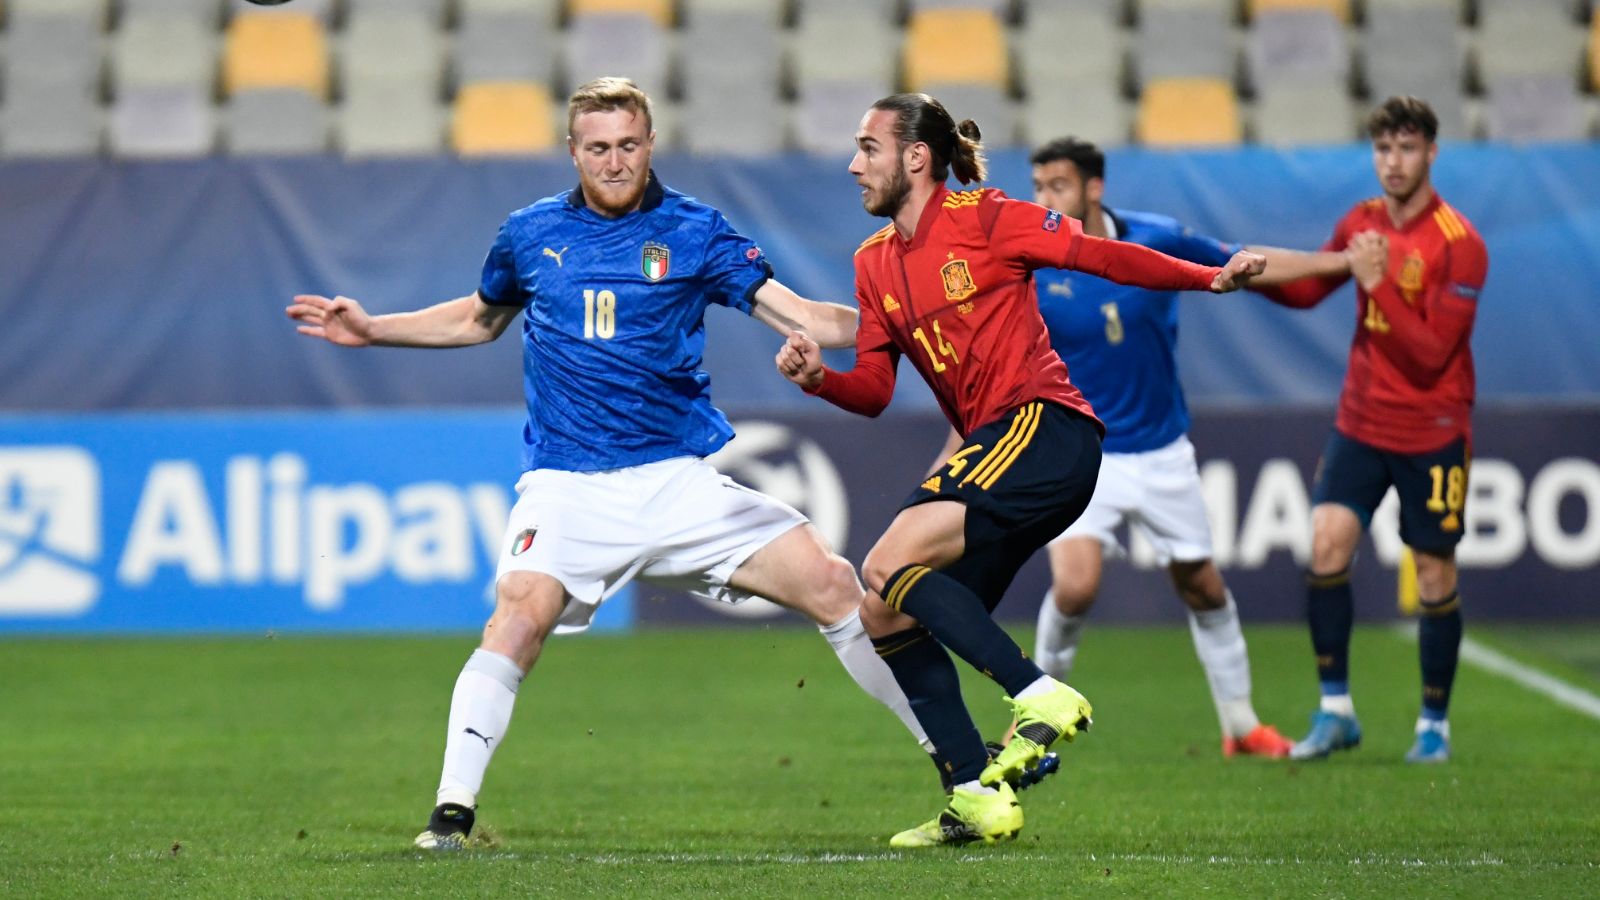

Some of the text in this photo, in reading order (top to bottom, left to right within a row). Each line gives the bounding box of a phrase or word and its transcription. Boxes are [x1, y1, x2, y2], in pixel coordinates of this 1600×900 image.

[583, 289, 616, 339] 18
[912, 319, 960, 373] 14
[1426, 464, 1465, 512] 18
